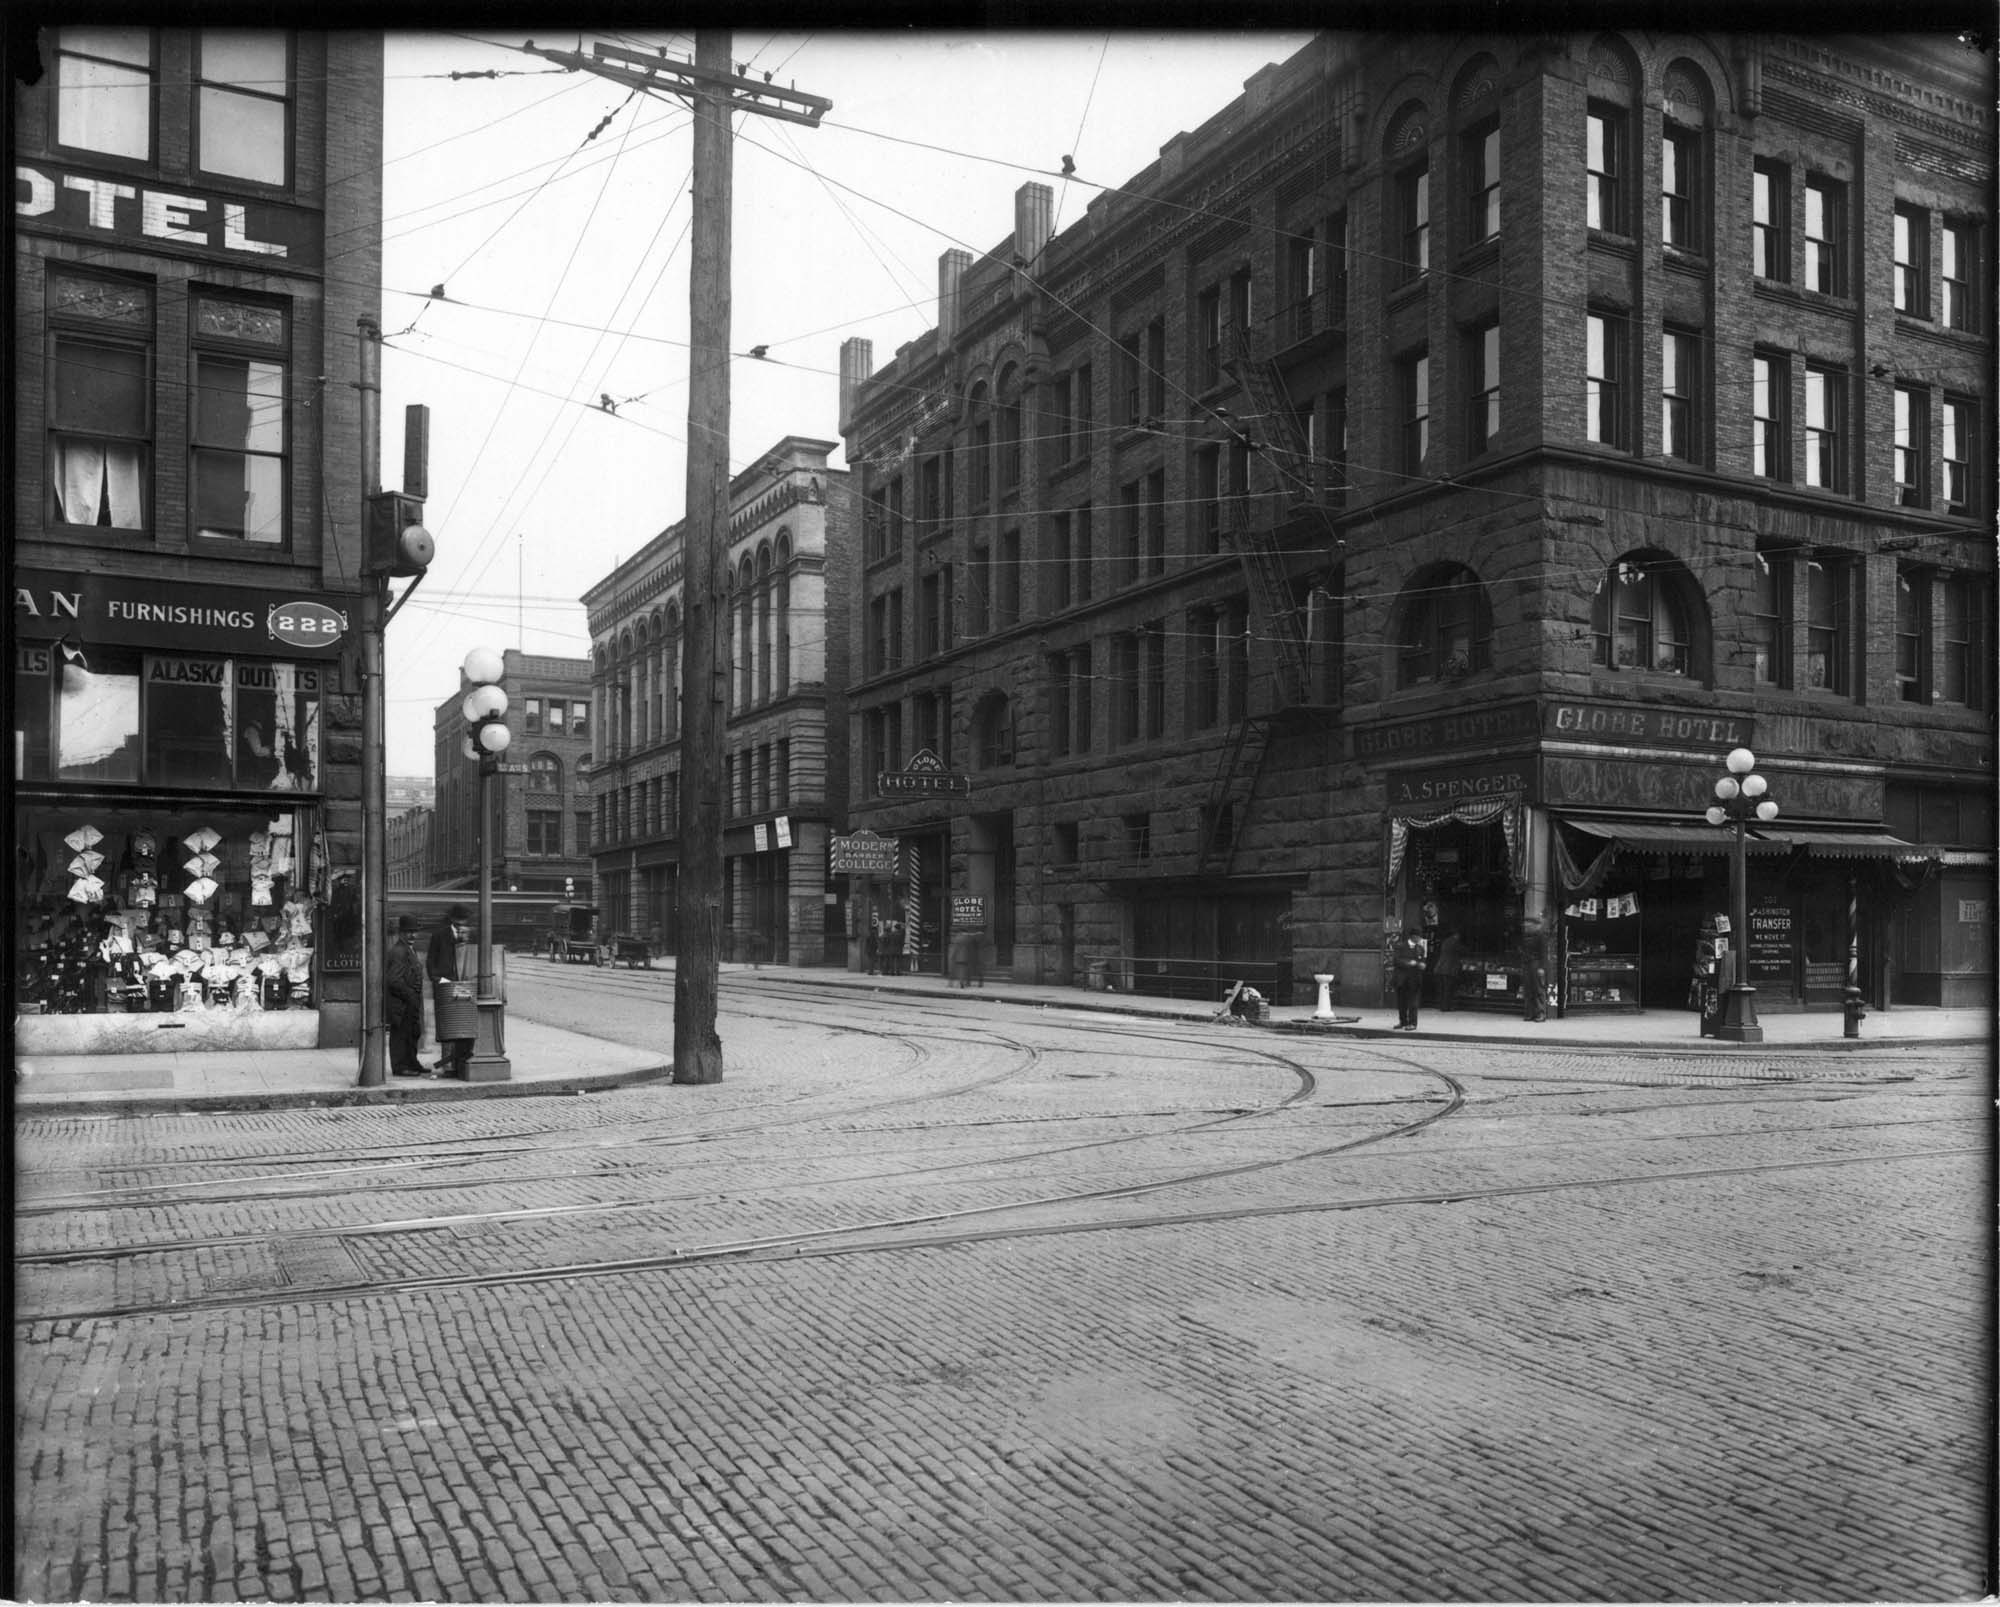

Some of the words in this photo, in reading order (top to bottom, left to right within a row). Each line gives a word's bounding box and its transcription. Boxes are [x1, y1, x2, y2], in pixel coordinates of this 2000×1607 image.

[16, 588, 83, 619] AN
[107, 600, 256, 629] FURNISHINGS
[278, 615, 338, 634] 222
[1554, 706, 1646, 737] GLOBE
[1359, 724, 1435, 754] GLOBE
[913, 756, 942, 771] GLOBE
[885, 775, 965, 790] HOTEL
[840, 839, 894, 852] MODERN
[837, 858, 892, 870] COLLEGE
[953, 897, 984, 906] GLOBE
[1752, 917, 1792, 929] TRANSFER
